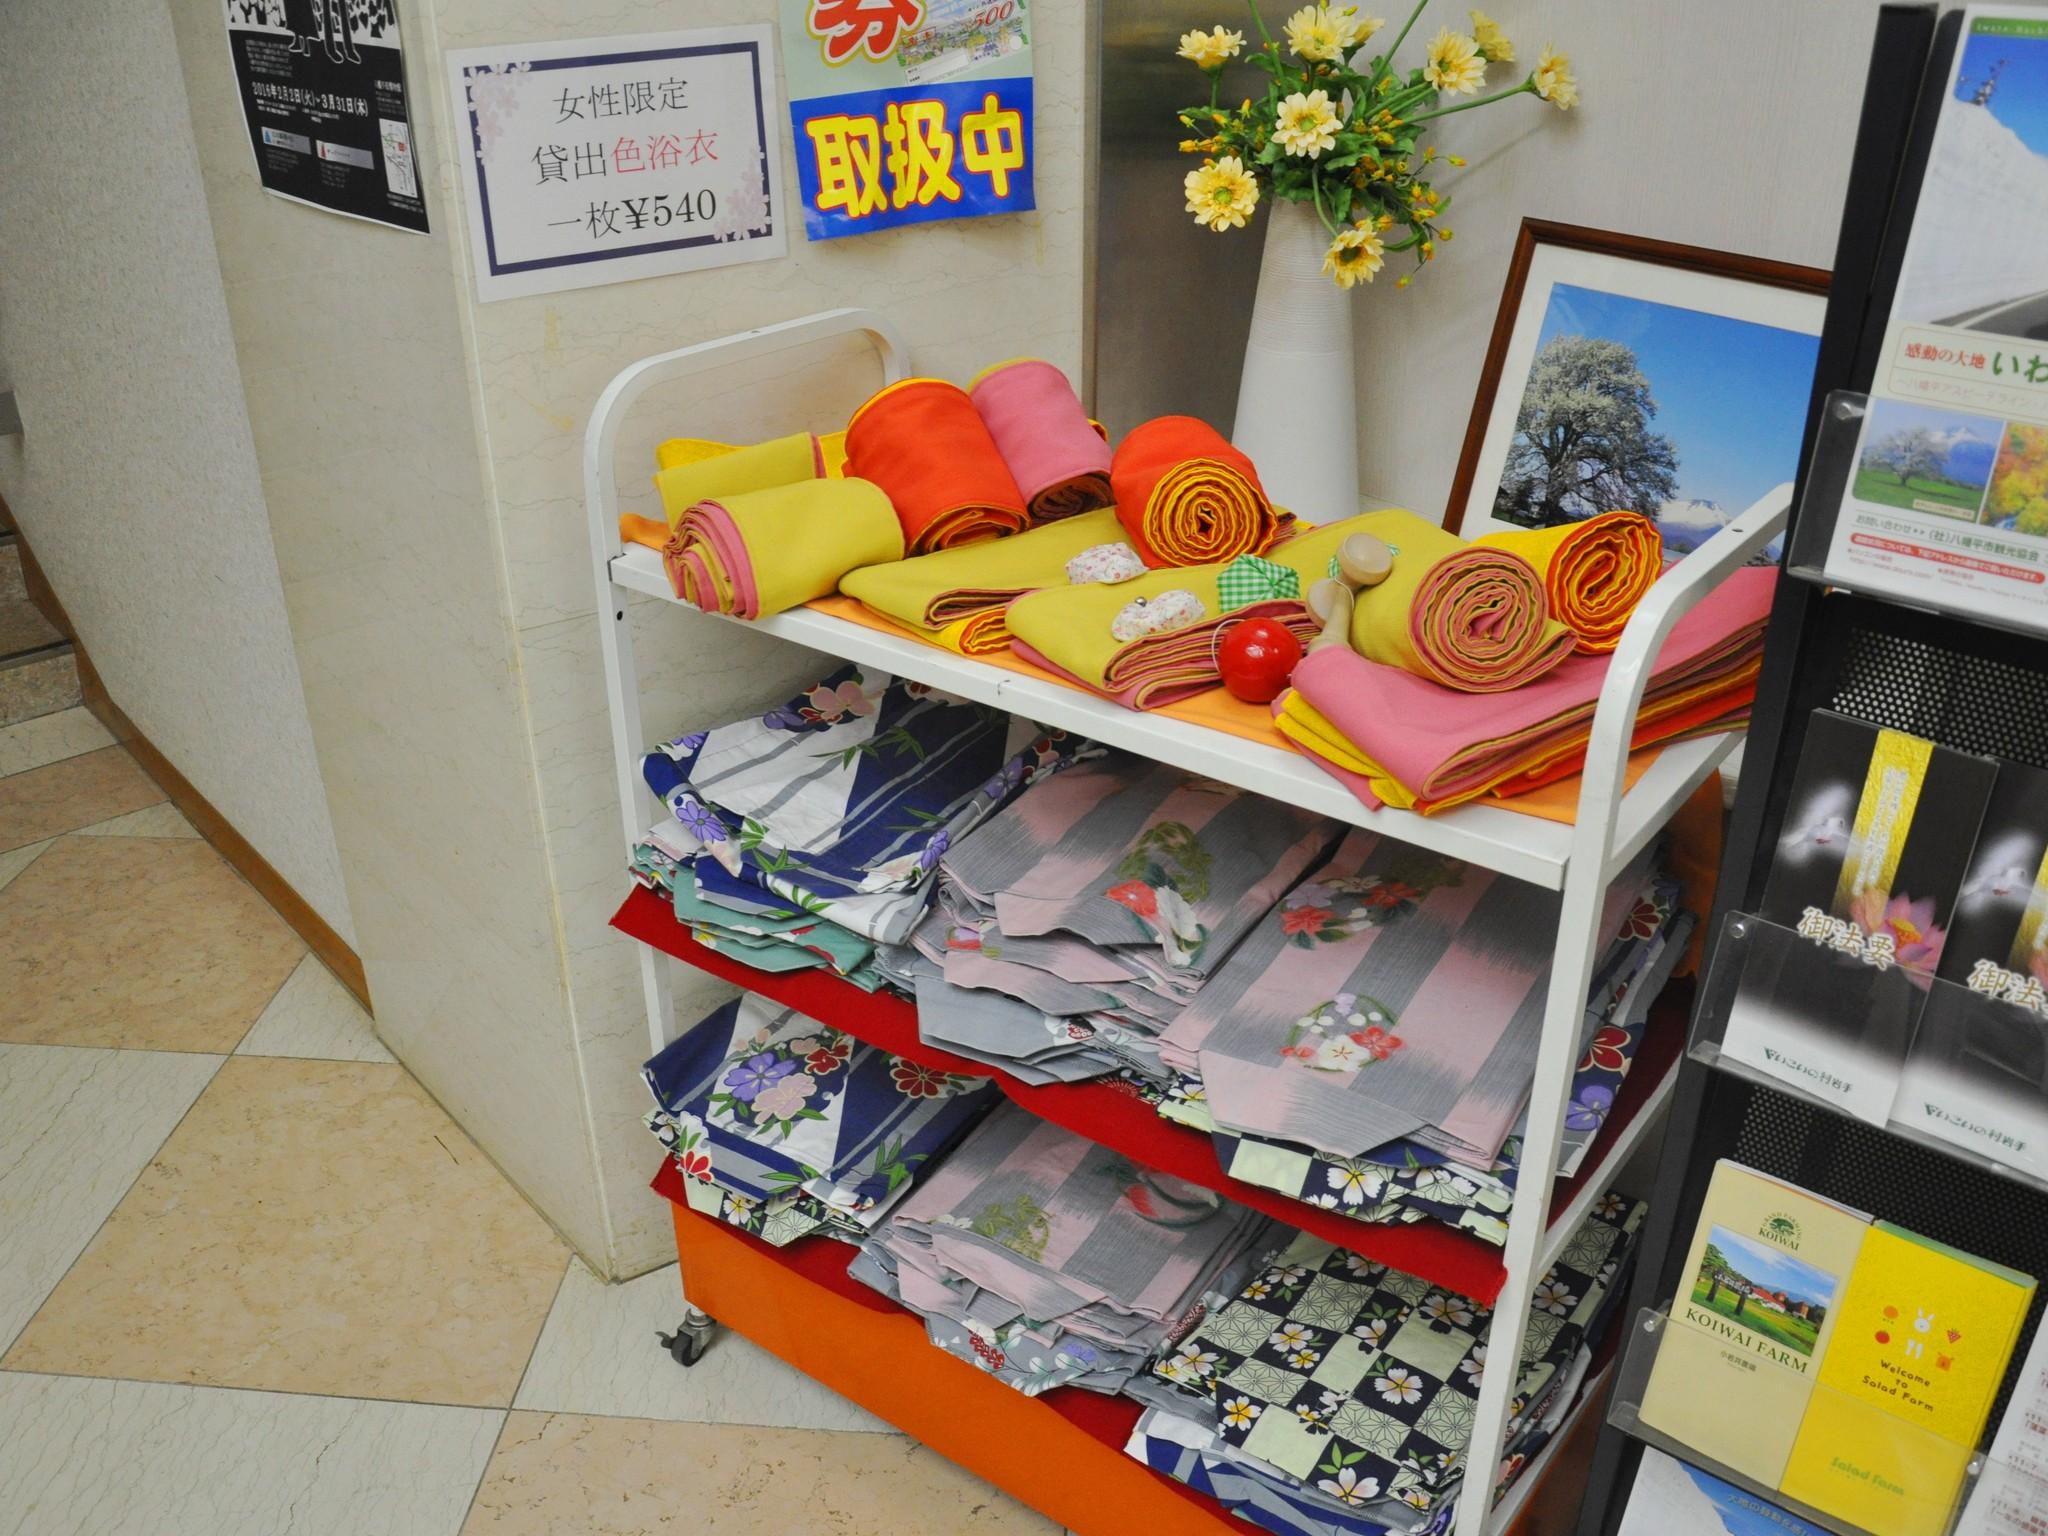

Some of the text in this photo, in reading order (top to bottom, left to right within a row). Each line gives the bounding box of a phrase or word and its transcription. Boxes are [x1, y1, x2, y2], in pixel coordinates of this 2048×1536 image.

[552, 77, 689, 124] 女性限定
[531, 128, 720, 186] 貸出色浴衣
[806, 93, 1024, 217] 取扱中
[1905, 343, 1985, 369] 感動の大地
[1797, 906, 1896, 972] 御法要
[1967, 958, 2048, 1021] 御法
[1759, 1227, 1800, 1251] KOIWAI
[1686, 1307, 1809, 1373] KOIWAI FARM
[1862, 1375, 1934, 1412] Salad Farm
[1880, 1359, 1931, 1387] Welcome
